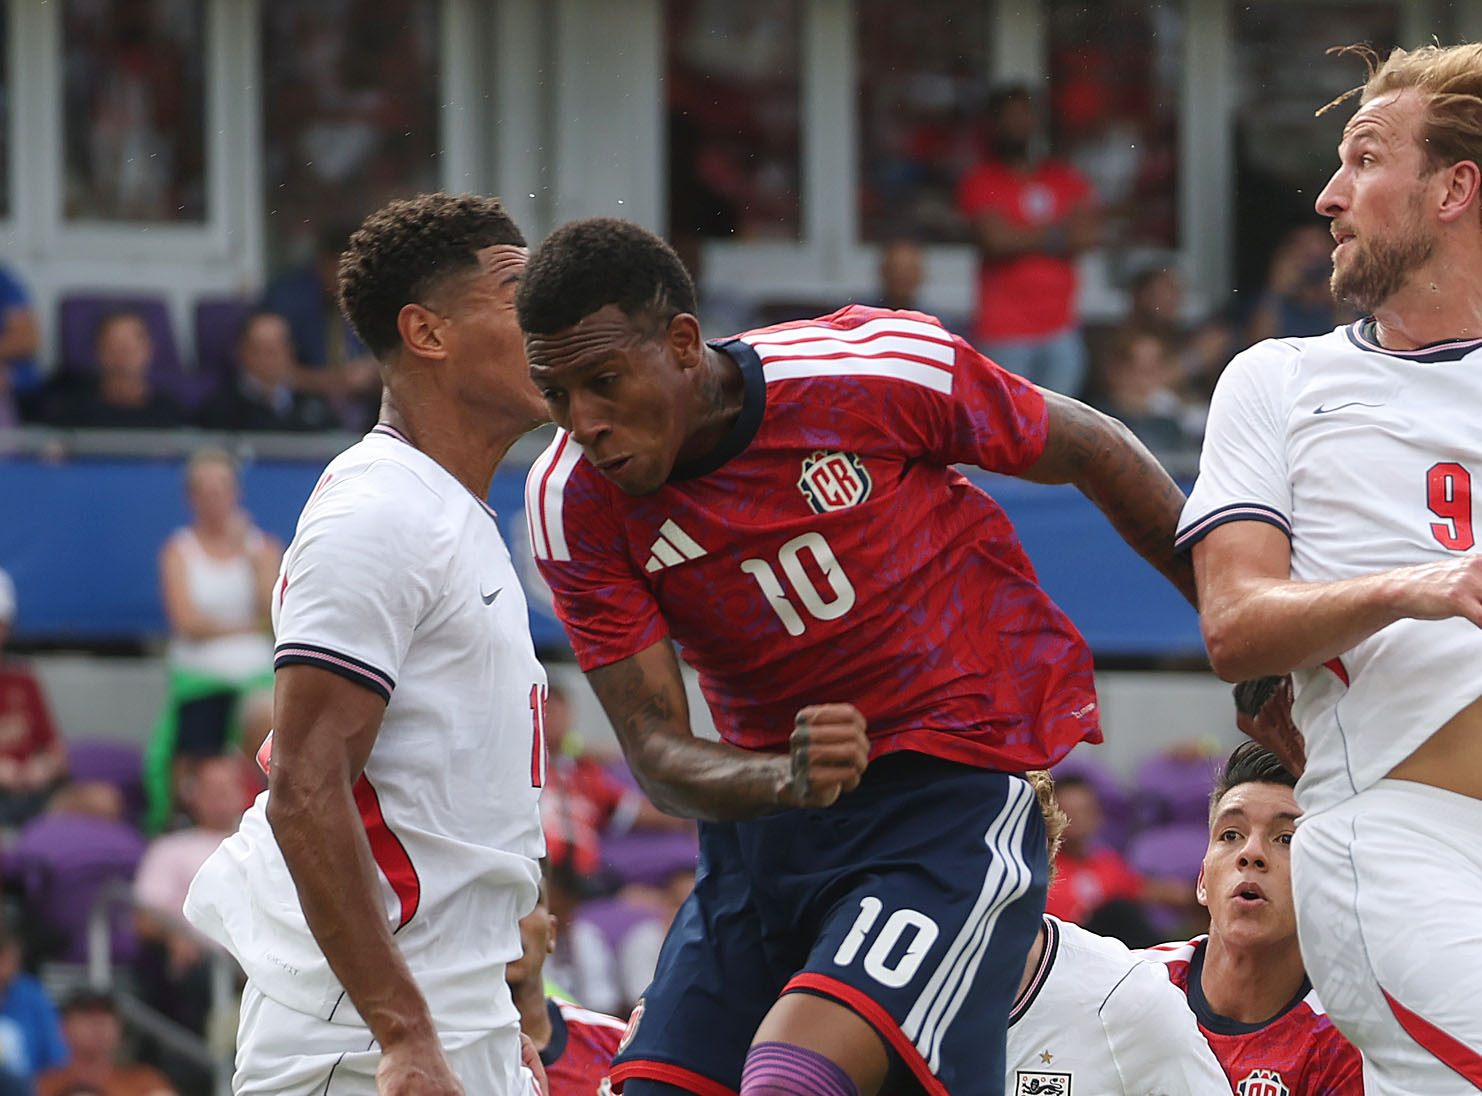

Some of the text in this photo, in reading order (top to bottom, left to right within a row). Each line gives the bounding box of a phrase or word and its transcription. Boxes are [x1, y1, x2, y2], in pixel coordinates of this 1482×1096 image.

[1426, 462, 1475, 552] 9
[740, 531, 856, 637] 10
[529, 683, 550, 788] 1
[833, 896, 940, 989] 10
